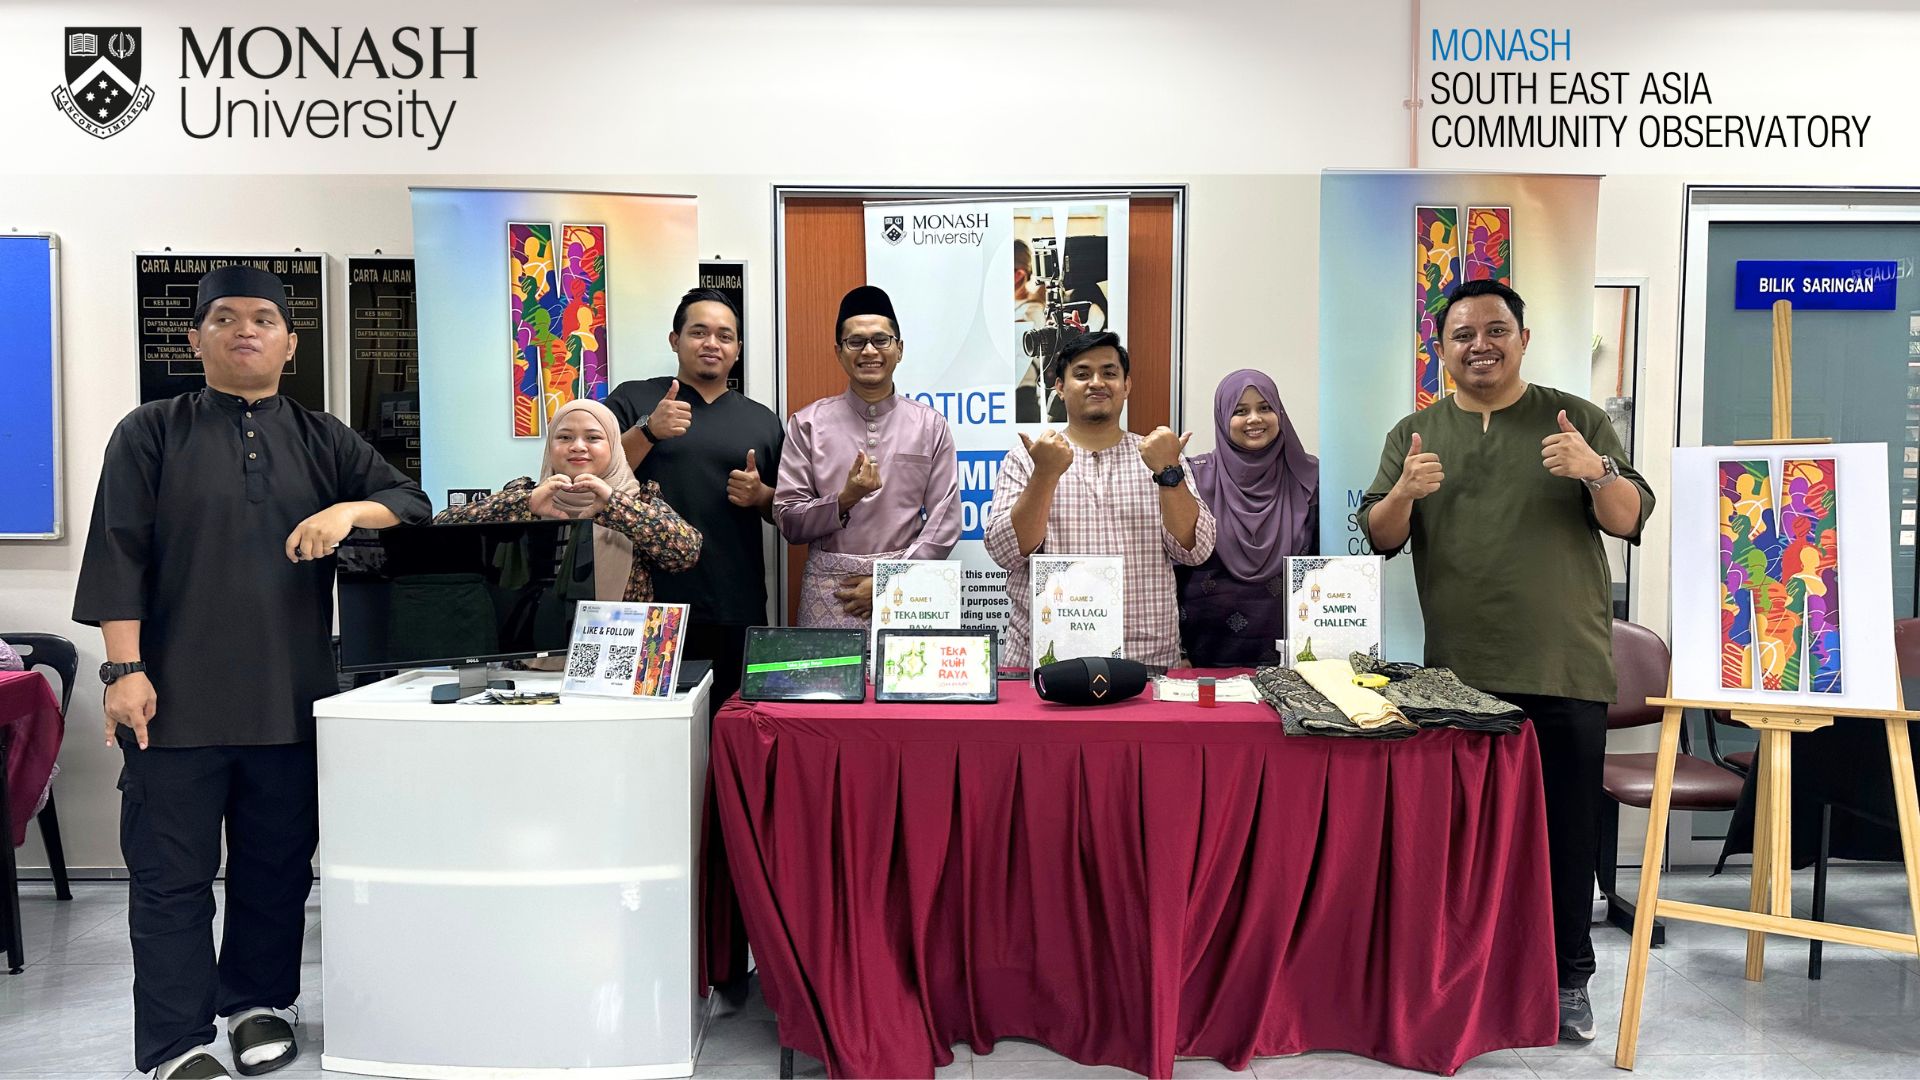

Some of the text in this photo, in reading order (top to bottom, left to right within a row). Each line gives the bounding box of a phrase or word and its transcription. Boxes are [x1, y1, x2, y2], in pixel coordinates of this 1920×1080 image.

[912, 213, 989, 229] MONASH
[912, 230, 984, 247] University
[141, 259, 170, 273] CARTA
[174, 259, 207, 273] ALIRAN
[273, 260, 288, 274] IBU
[291, 260, 319, 274] HAMIL
[353, 269, 412, 283] CARTA ALIRAN
[701, 275, 742, 289] KELUARGA
[1759, 277, 1874, 293] BILIK SARINGAN
[965, 570, 983, 579] this
[967, 599, 1009, 607] purposes
[1057, 608, 1108, 617] TEKA LAGU
[1322, 604, 1357, 613] SAMPIN
[894, 610, 950, 620] TEKA BISKUT
[1070, 622, 1096, 631] RAYA
[1314, 618, 1368, 627] CHALLENGE
[582, 626, 635, 636] LIKE & FOLLOW
[940, 646, 967, 656] TEKA
[938, 669, 968, 679] RAYA
